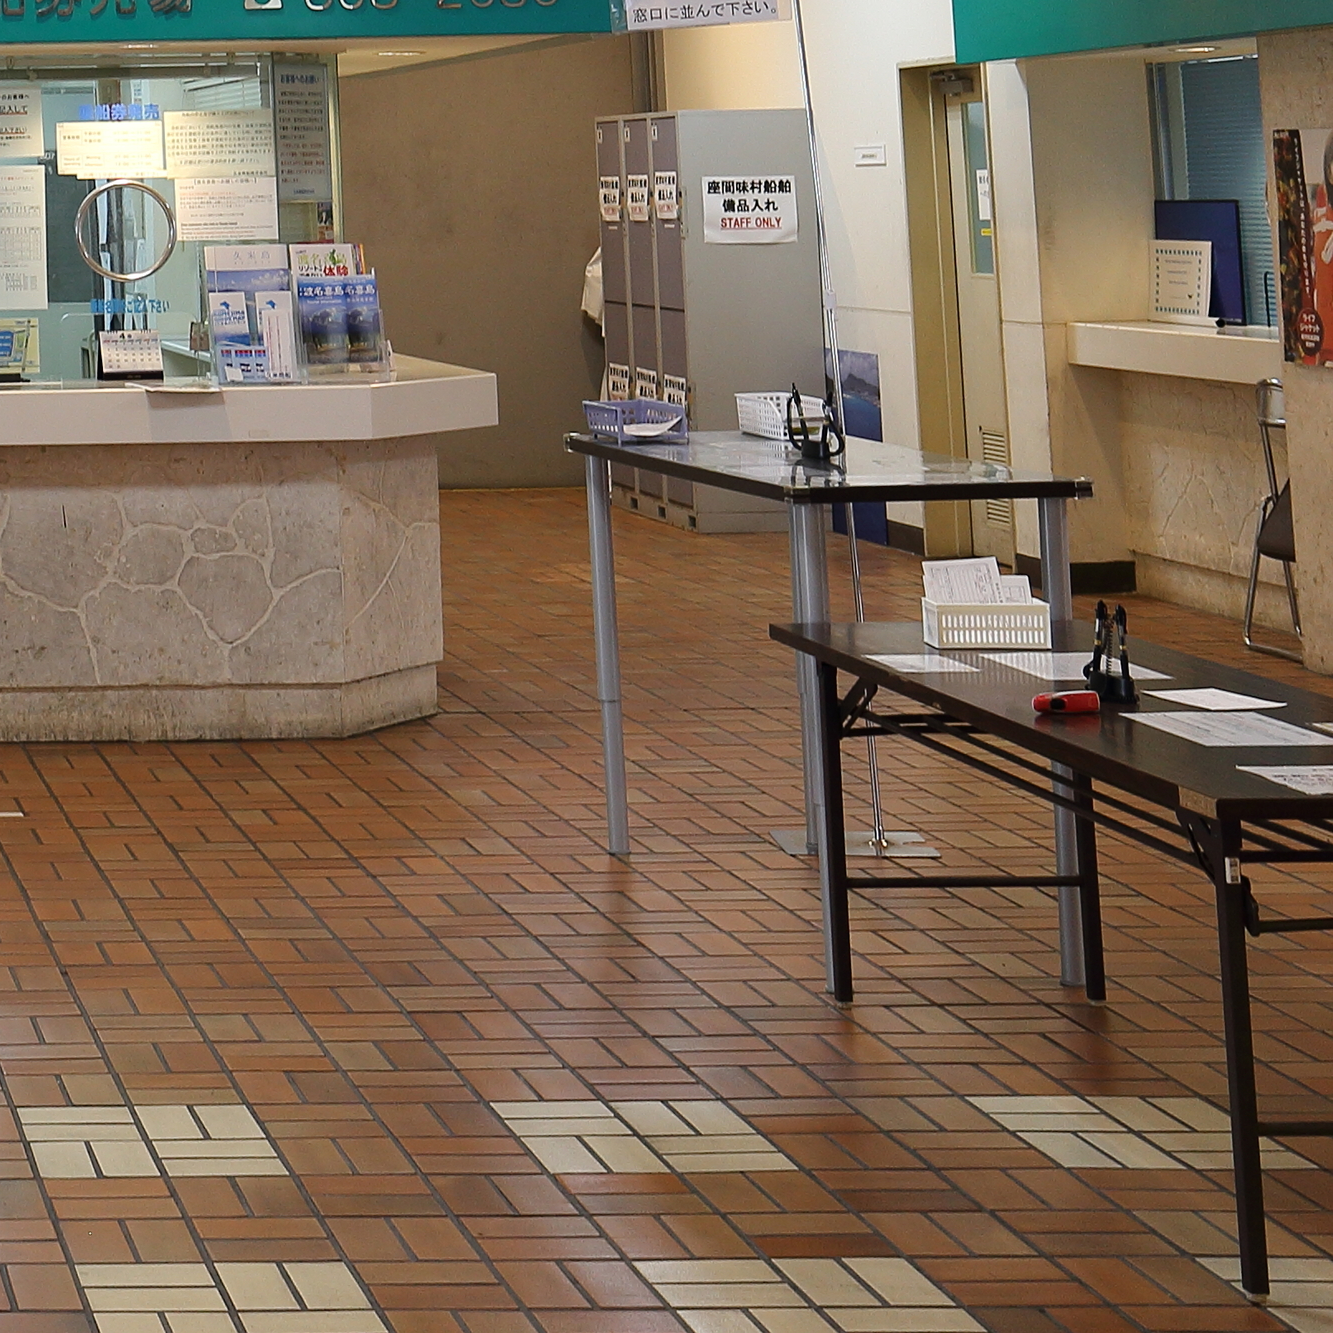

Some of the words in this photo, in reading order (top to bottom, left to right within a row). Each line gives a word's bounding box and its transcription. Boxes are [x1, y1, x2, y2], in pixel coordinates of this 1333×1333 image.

[632, 0, 779, 24] 窓口に並んで下さい。
[707, 179, 792, 195] 座間味村船舶
[721, 199, 779, 213] 備品入れ
[720, 217, 752, 229] STAFF
[754, 216, 782, 229] ONLY
